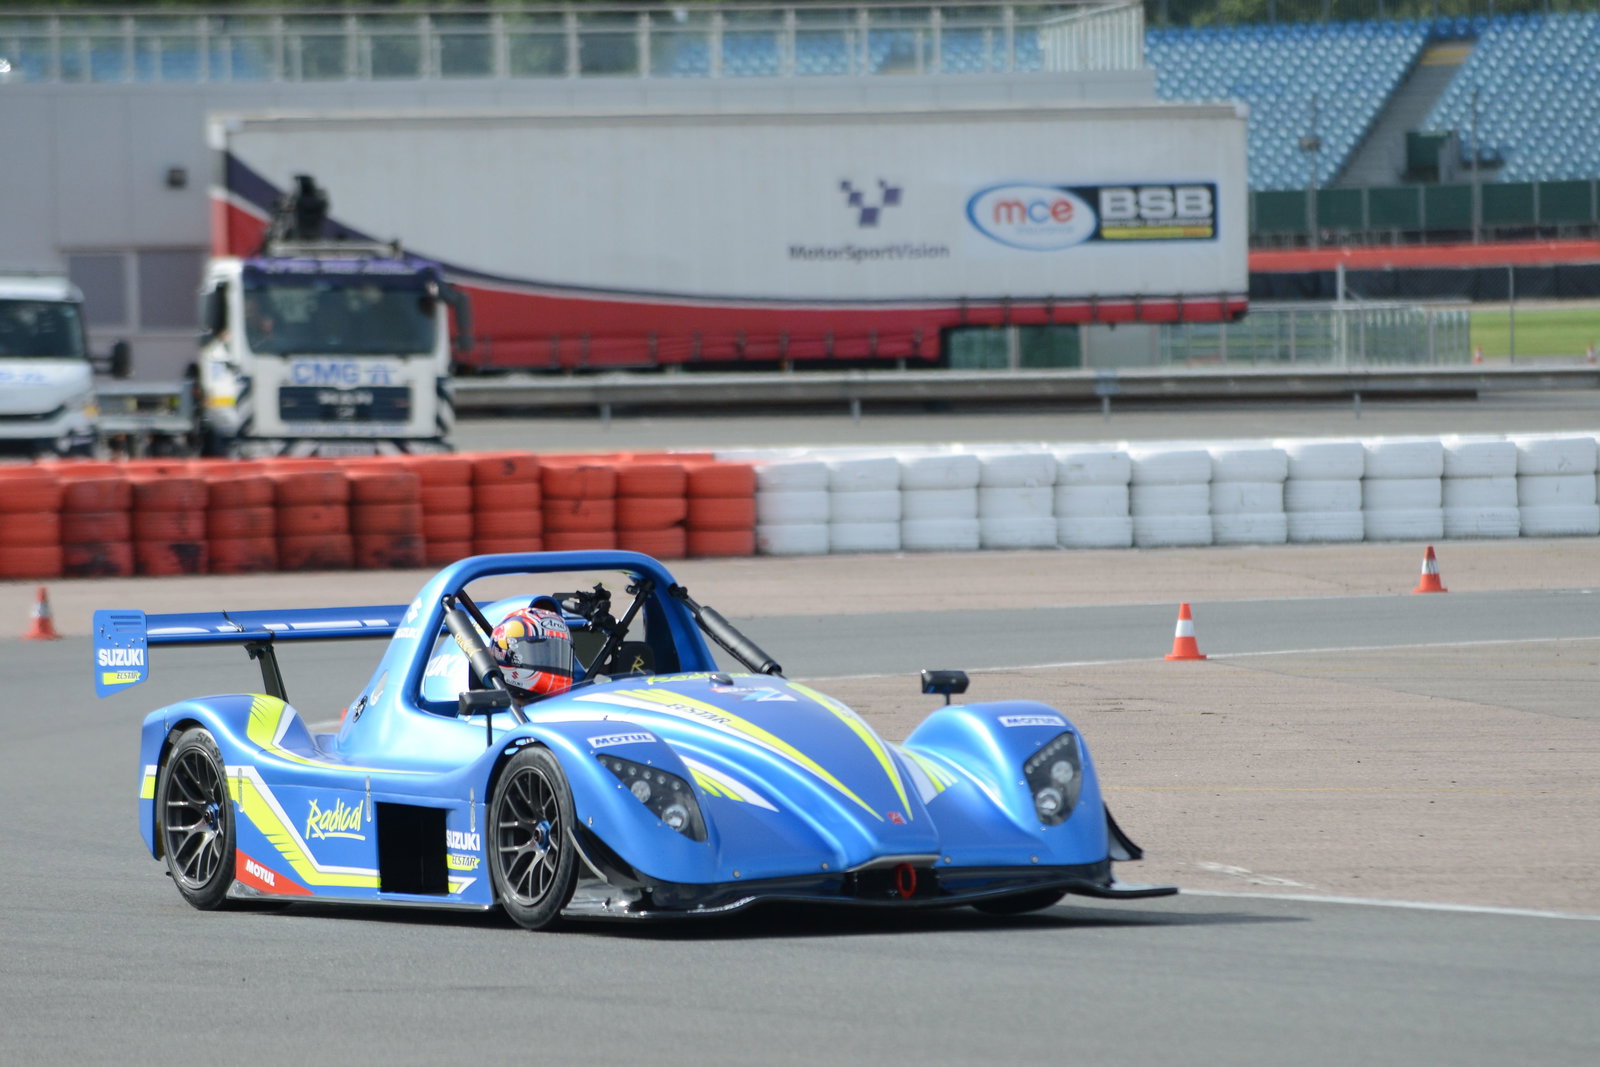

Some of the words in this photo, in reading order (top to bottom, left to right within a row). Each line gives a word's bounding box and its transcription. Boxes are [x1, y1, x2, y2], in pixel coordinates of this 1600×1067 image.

[993, 199, 1075, 224] mce
[1101, 187, 1213, 219] BSB
[292, 362, 359, 384] CMG
[98, 648, 144, 667] SUZUKI
[595, 734, 652, 745] MOTUL
[306, 797, 364, 840] Radical
[446, 829, 480, 851] SUZUKI
[452, 855, 476, 867] ECSTAR
[245, 859, 275, 887] MOTUL
